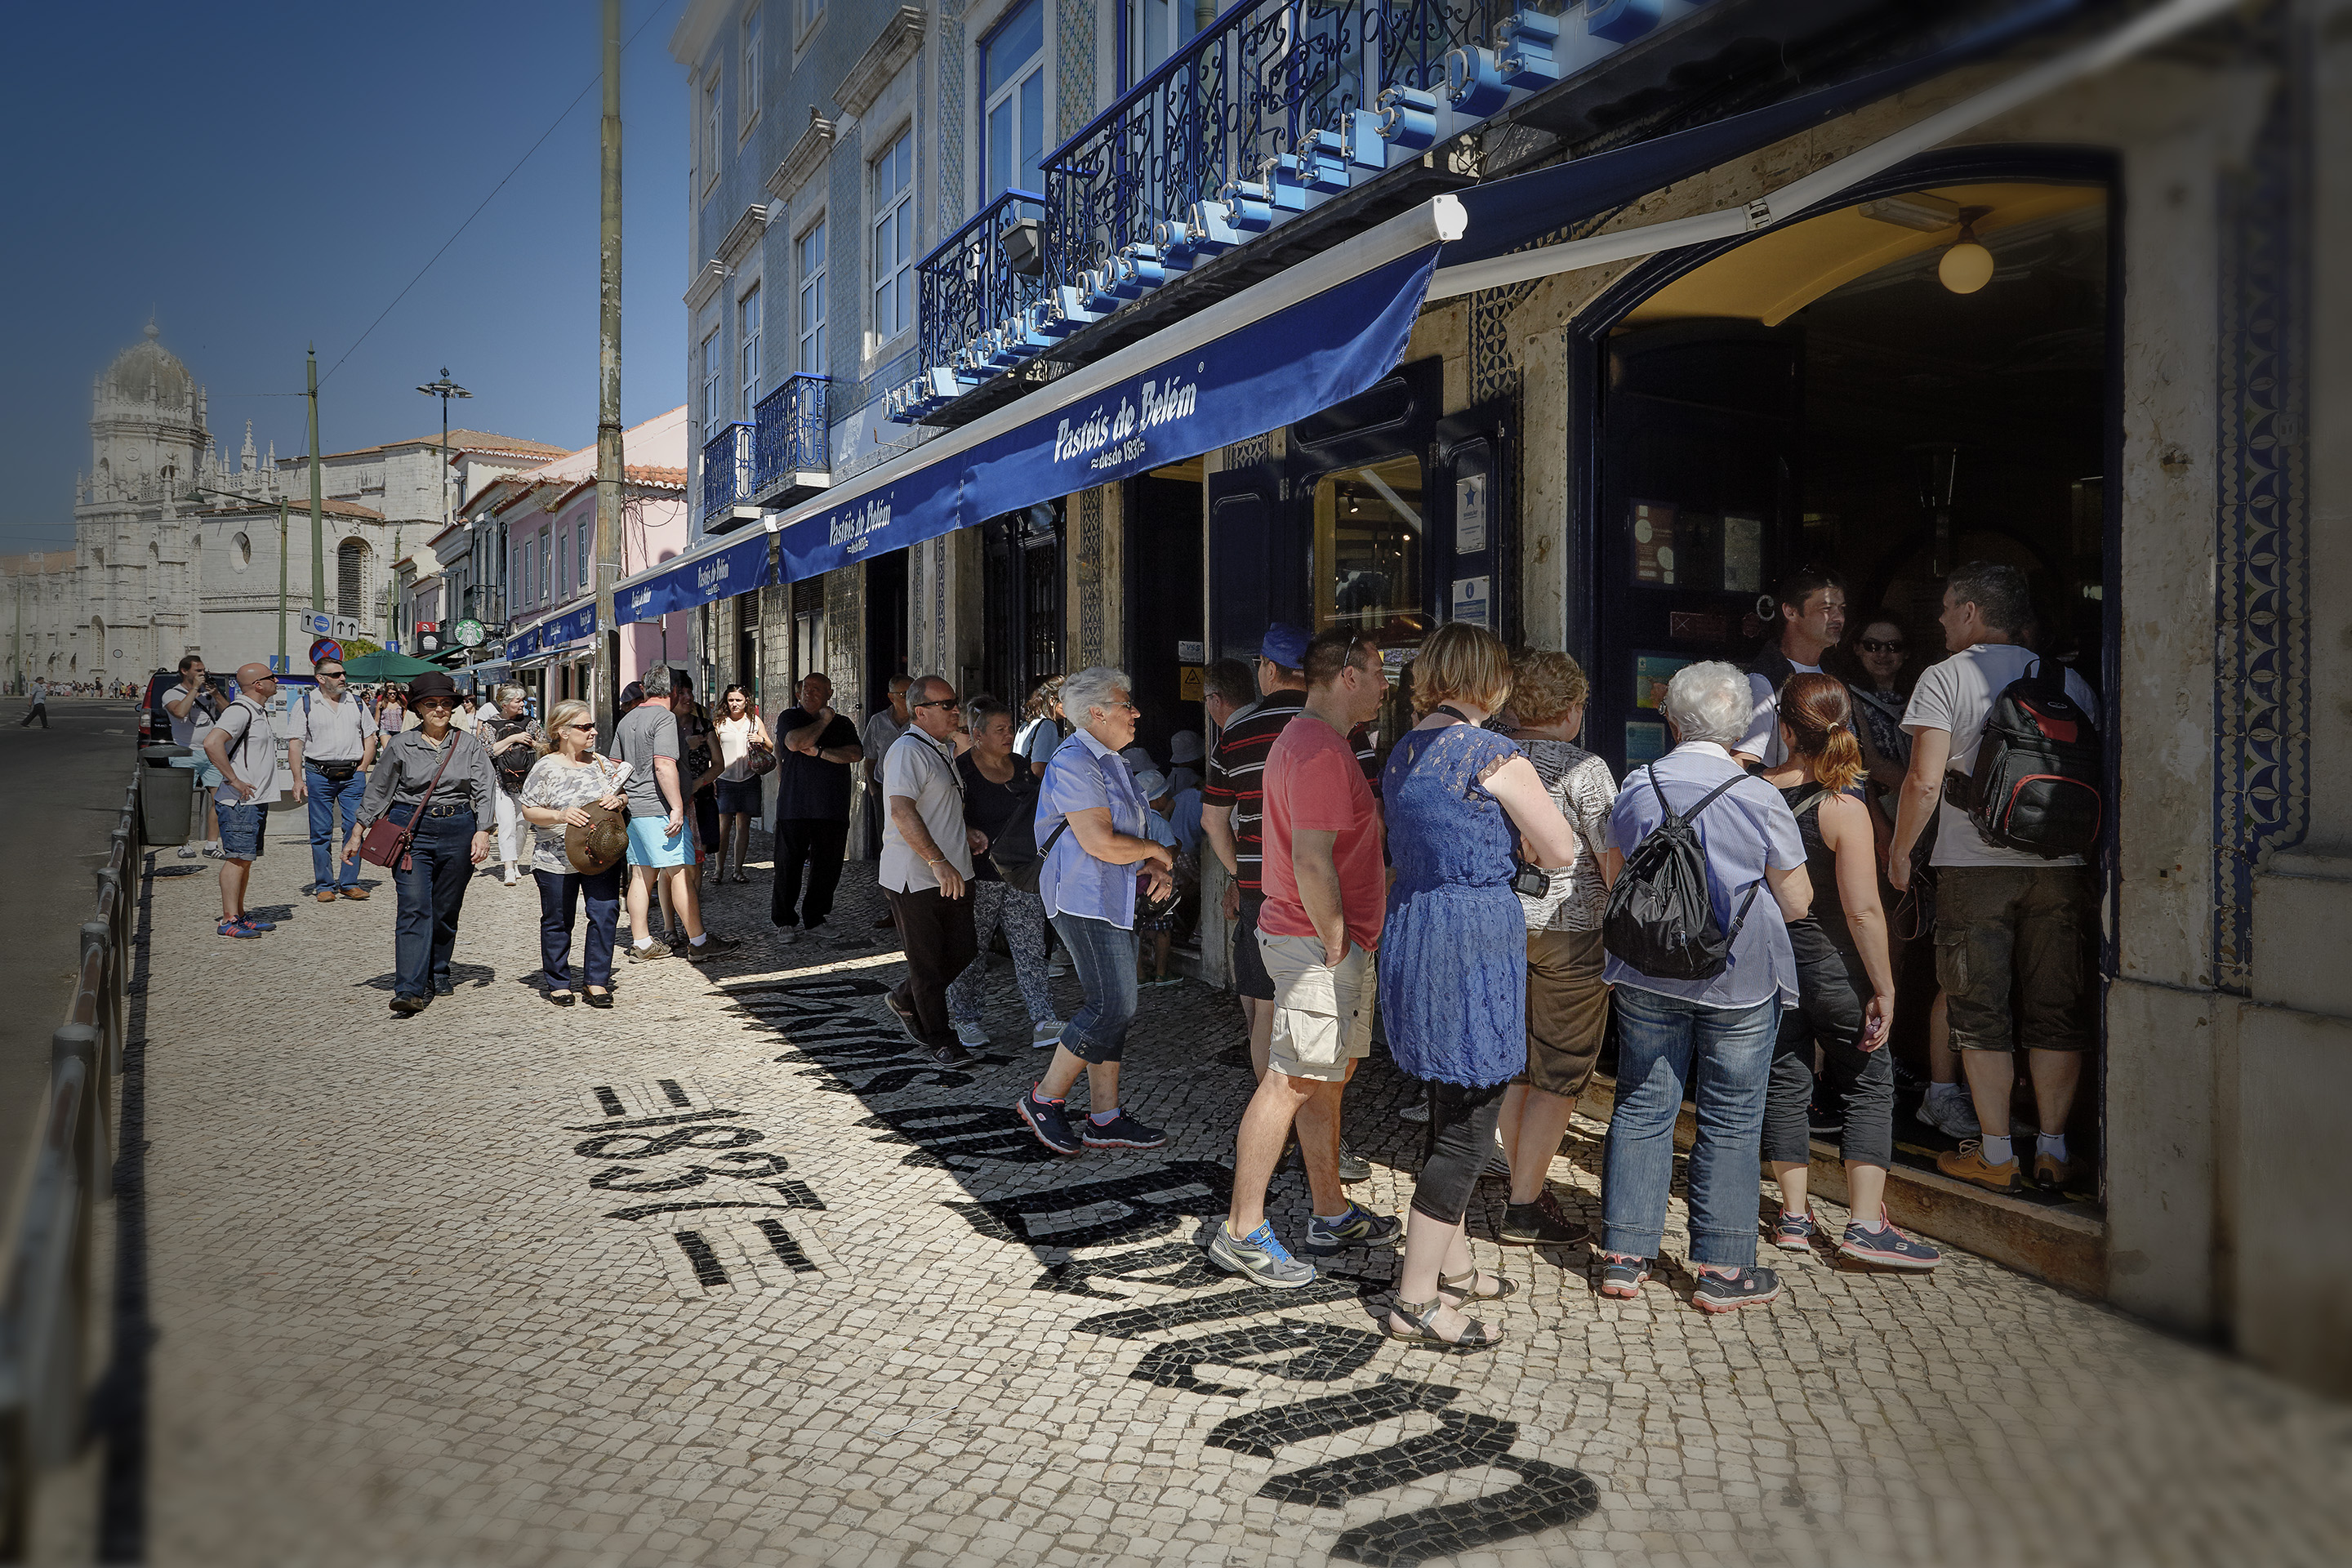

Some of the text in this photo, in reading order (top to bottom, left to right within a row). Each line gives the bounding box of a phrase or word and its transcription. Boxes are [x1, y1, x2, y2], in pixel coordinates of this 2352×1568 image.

[1054, 376, 1197, 464] Pastéis de Belém
[1123, 437, 1141, 463] 1837
[830, 499, 891, 547] Pastéis de Belém
[564, 1107, 827, 1221] 1837
